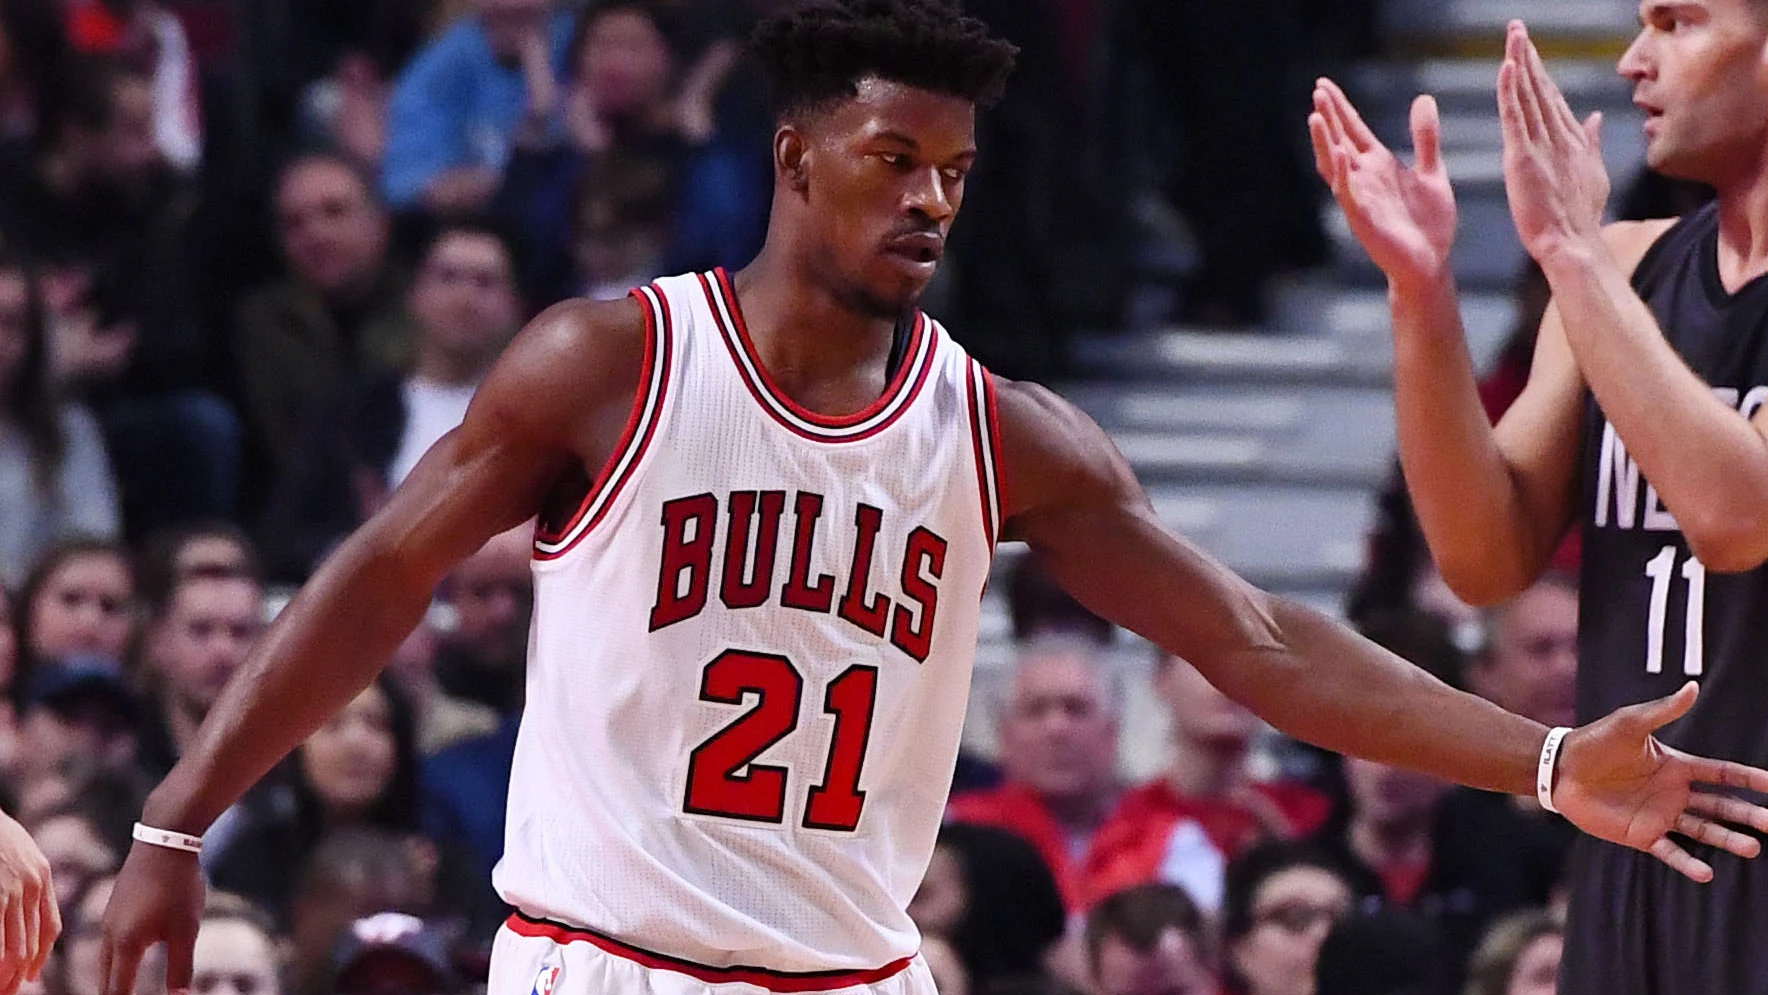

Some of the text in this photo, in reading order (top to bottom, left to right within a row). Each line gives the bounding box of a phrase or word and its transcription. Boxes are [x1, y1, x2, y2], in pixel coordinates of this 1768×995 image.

[649, 490, 948, 664] BULLS
[1646, 545, 1705, 676] 11
[683, 648, 878, 832] 21
